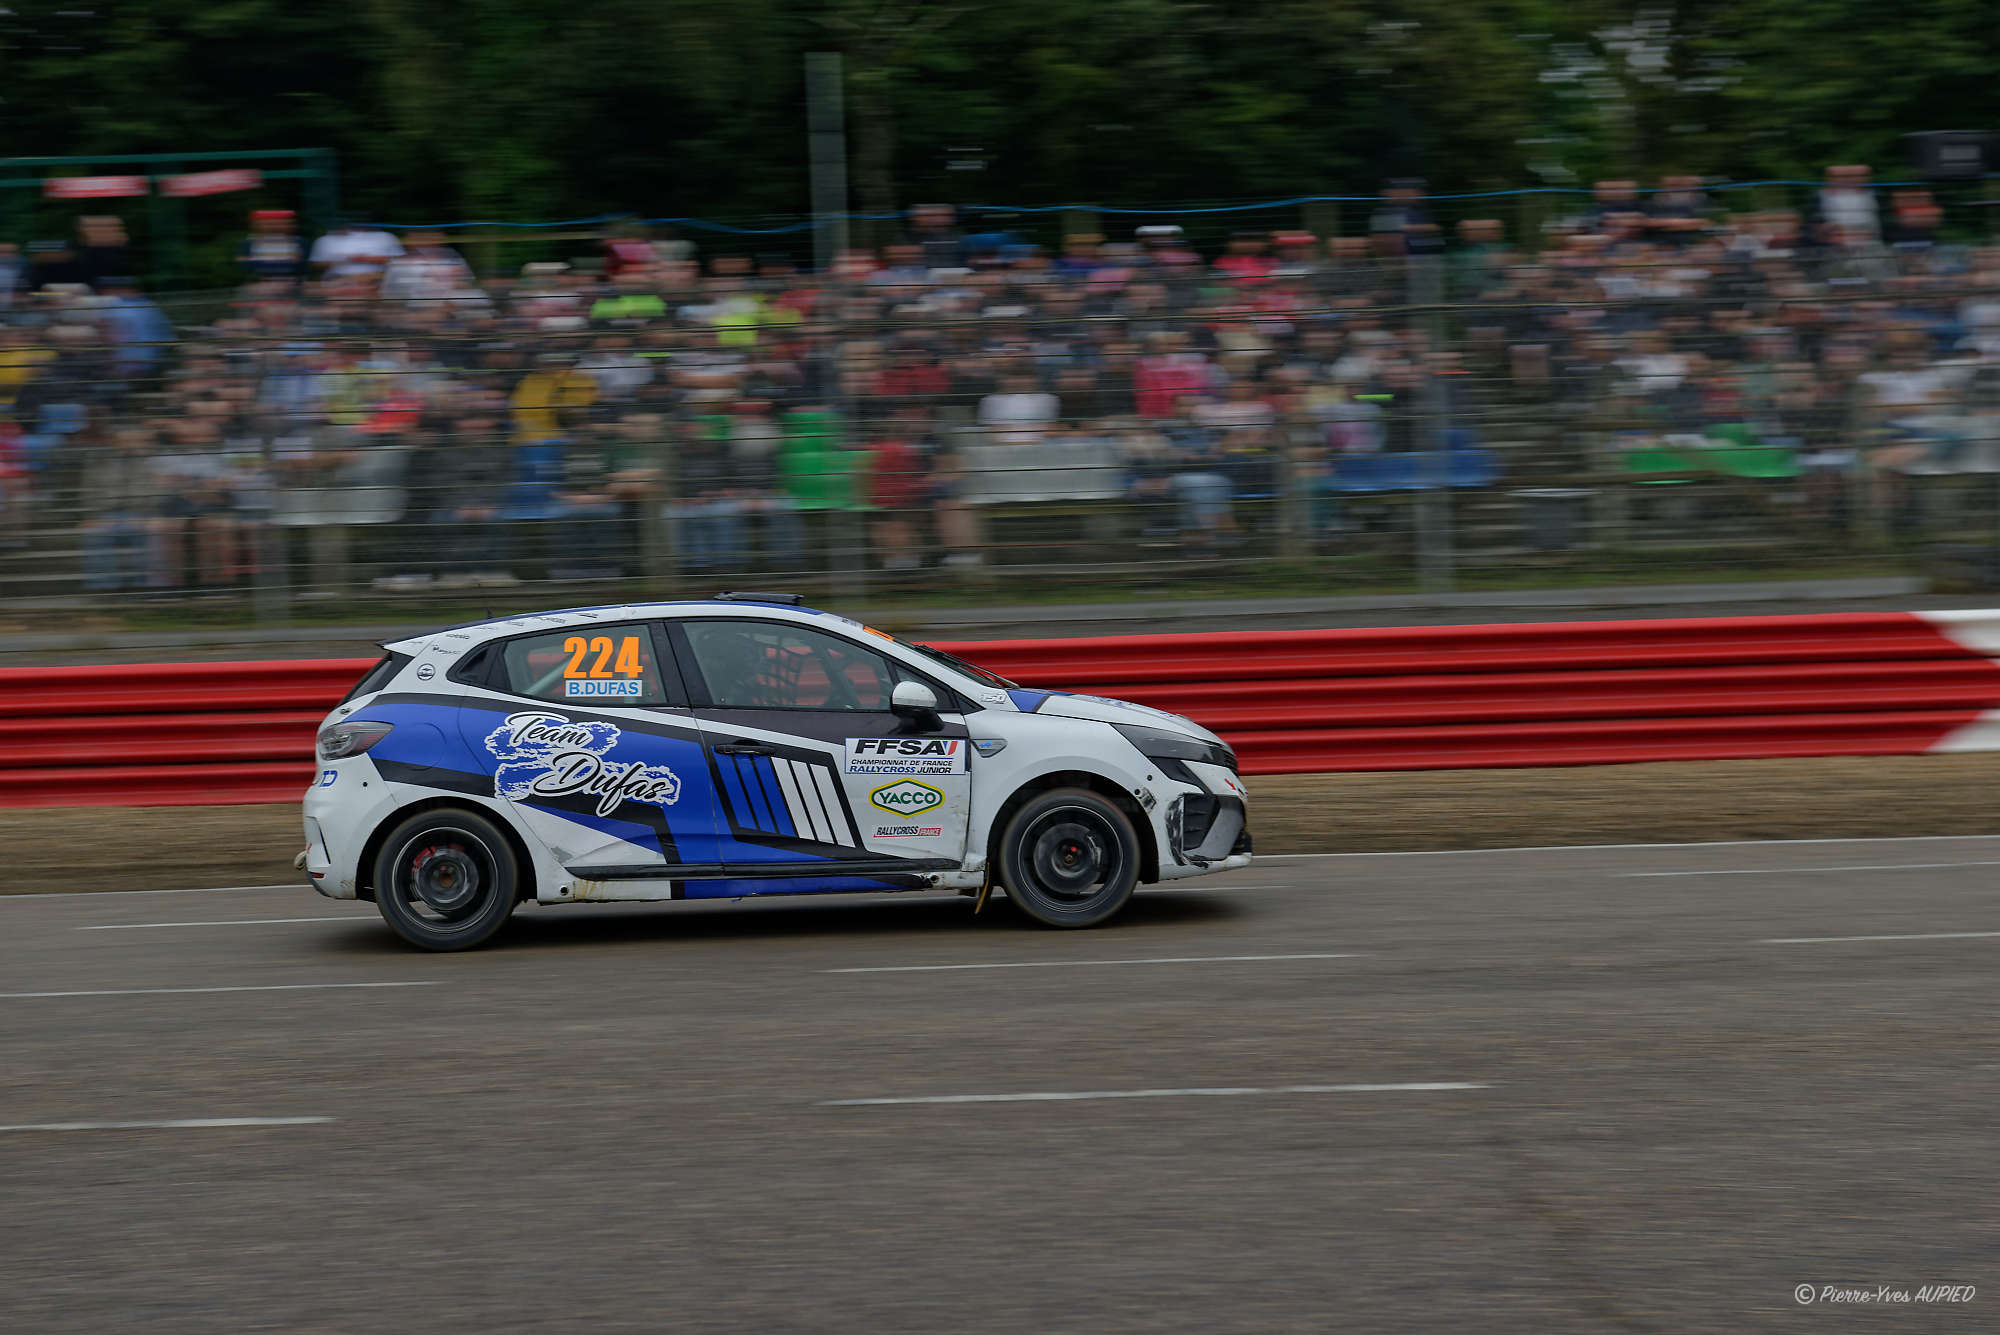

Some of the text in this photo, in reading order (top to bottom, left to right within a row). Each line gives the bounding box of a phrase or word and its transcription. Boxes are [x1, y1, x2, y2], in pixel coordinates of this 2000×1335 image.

[563, 636, 643, 679] 224
[569, 682, 639, 695] B.DUFAS
[507, 712, 592, 746] Team
[855, 739, 946, 755] FFSA
[849, 765, 951, 774] RALLYCROSS JUNIOR
[533, 751, 671, 814] Dufas
[879, 792, 937, 804] YACCO
[877, 826, 919, 835] RALLYCROSS
